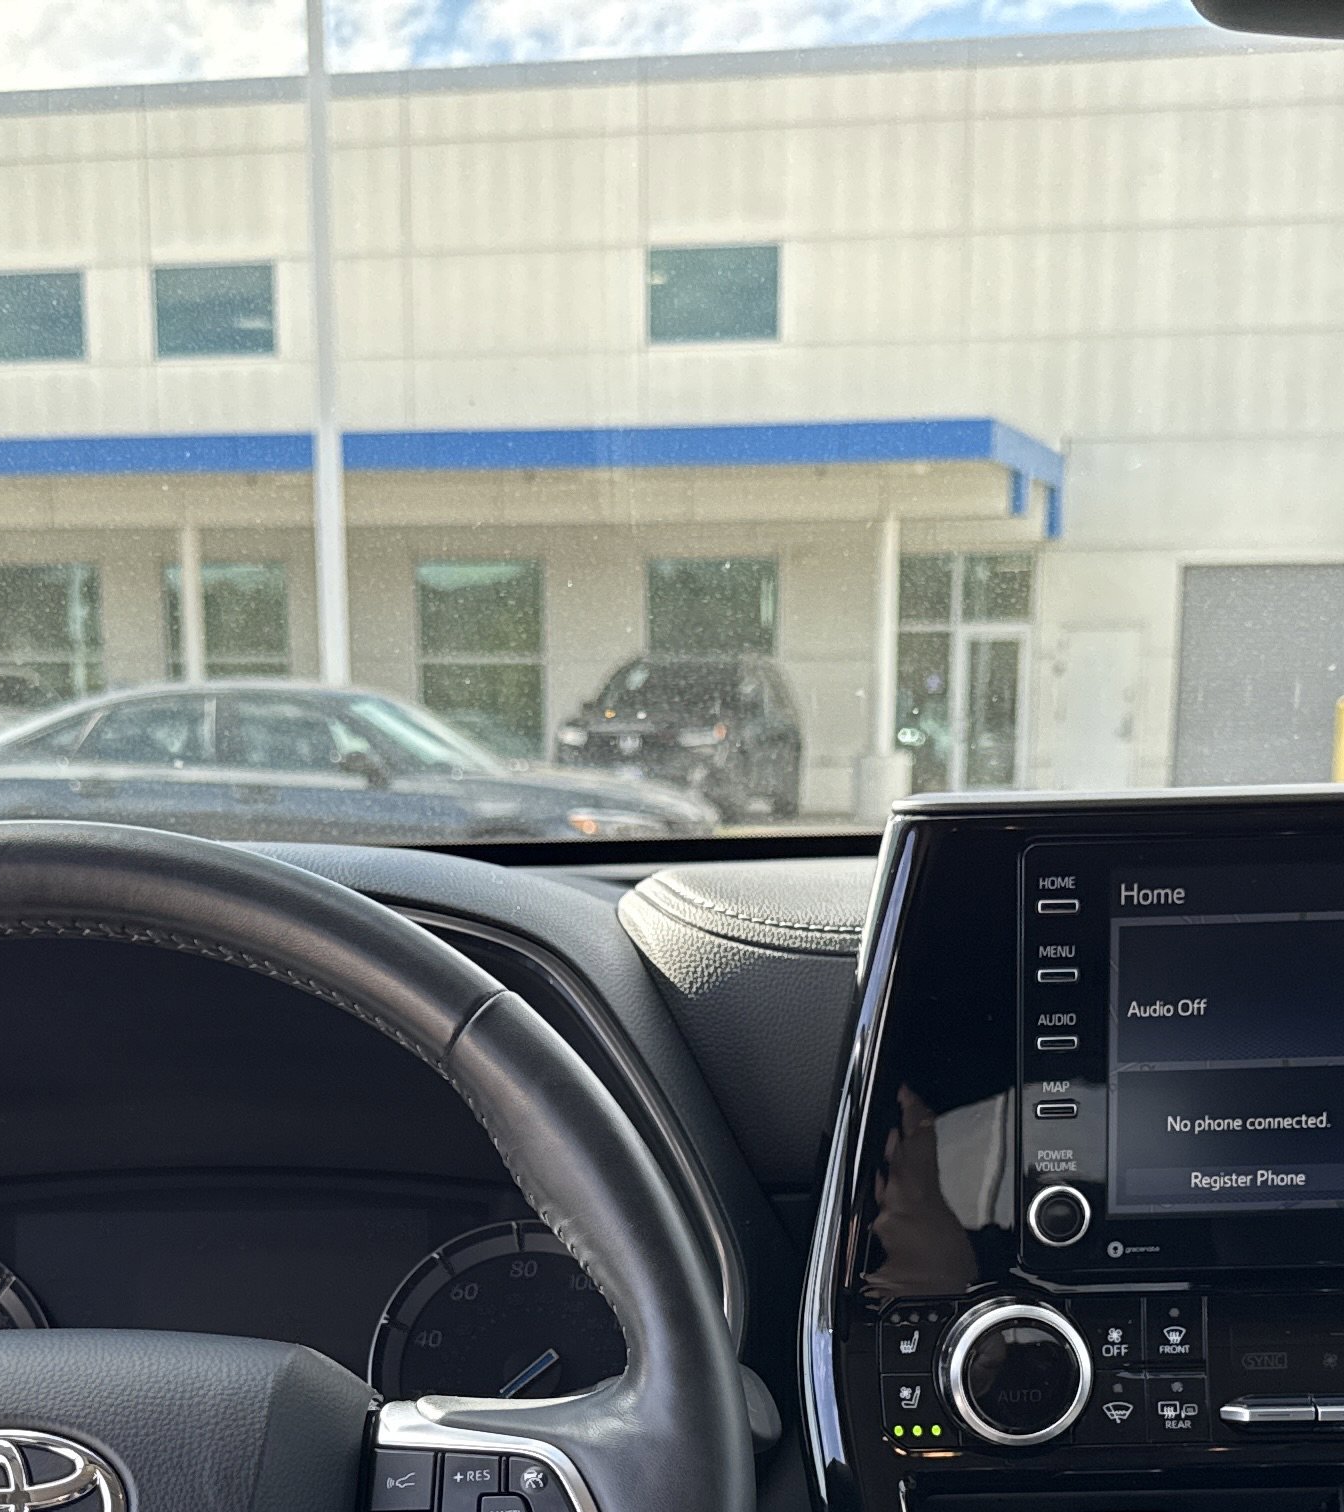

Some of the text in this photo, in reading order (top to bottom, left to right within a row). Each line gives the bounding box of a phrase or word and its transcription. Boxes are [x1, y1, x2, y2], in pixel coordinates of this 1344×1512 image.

[1039, 876, 1076, 890] HOME
[1120, 882, 1186, 906] Home
[1038, 945, 1075, 958] MENU
[1127, 998, 1207, 1018] Audio Off
[1038, 1013, 1077, 1027] AUDIO
[1042, 1081, 1070, 1093] MAP
[1166, 1111, 1332, 1134] No phone connected.
[1038, 1149, 1074, 1161] POWER
[1035, 1160, 1078, 1173] VOLUME
[1190, 1169, 1306, 1191] Register Phone
[510, 1259, 538, 1279] 80
[450, 1282, 479, 1301] 60
[1102, 1344, 1128, 1357] OFF
[1159, 1344, 1190, 1354] FRONT
[998, 1388, 1042, 1403] AUTO
[1165, 1420, 1192, 1429] REAR
